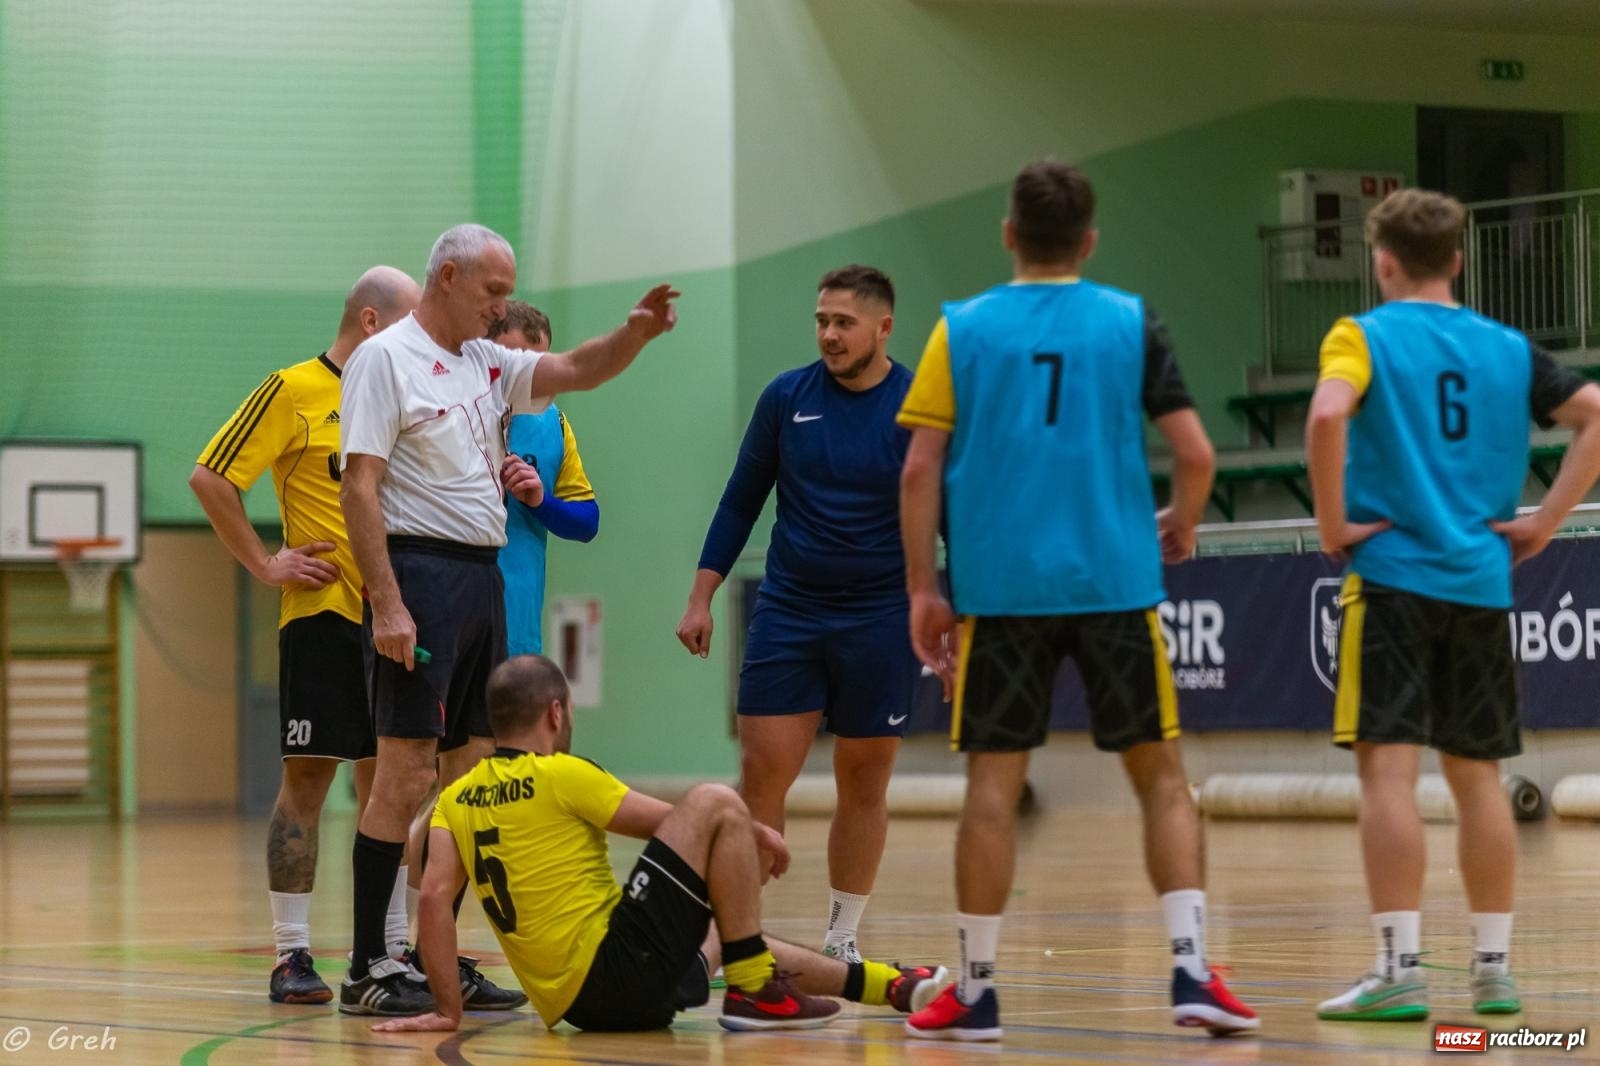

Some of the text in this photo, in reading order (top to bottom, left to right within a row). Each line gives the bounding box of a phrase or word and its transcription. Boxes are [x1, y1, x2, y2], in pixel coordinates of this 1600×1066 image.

[1032, 352, 1063, 427] 7
[1437, 370, 1468, 442] 6
[286, 718, 312, 746] 20
[474, 826, 517, 934] 5
[628, 870, 650, 899] 5
